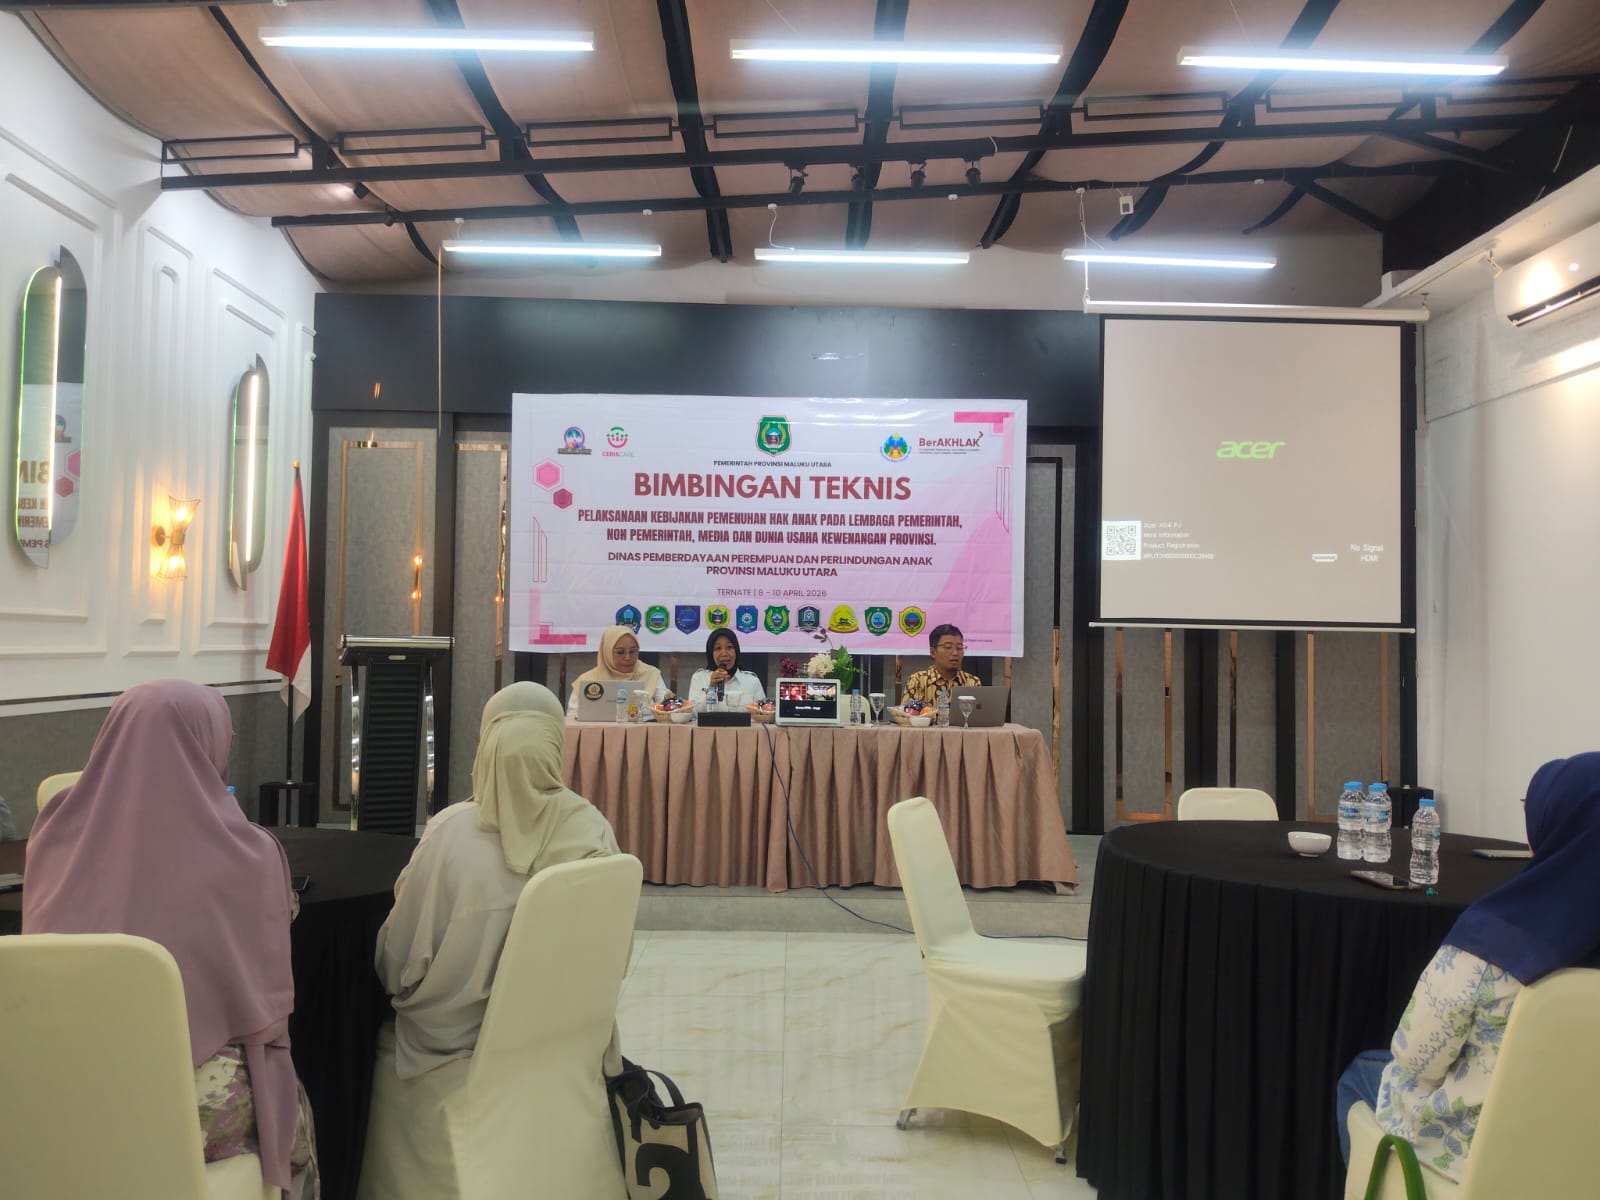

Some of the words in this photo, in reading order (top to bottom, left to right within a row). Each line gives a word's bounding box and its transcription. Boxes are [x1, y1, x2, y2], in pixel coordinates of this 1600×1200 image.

[919, 437, 981, 448] BerAKHLAK
[1216, 441, 1285, 459] acer
[634, 472, 801, 499] BIMBINGAN
[810, 476, 911, 500] TEKNIS
[578, 509, 648, 523] PELAKSANAAN
[650, 510, 704, 524] KEBIJAKAN
[707, 511, 767, 525] PEMENUHAN
[769, 512, 789, 526] HAK
[791, 513, 818, 526] ANAK
[820, 513, 846, 527] PADA
[849, 514, 895, 528] LEMBAGA
[899, 514, 963, 529] PEMERINTAH,
[606, 528, 627, 541] NON
[629, 529, 695, 544] PEMERINTAH,
[698, 530, 730, 543] MEDIA
[732, 530, 751, 543] DAN
[755, 531, 784, 543] DUNIA
[786, 531, 819, 544] USAHA
[821, 532, 887, 546] KEWENANGAN
[889, 533, 937, 546] PROVINSI.
[1350, 543, 1361, 552] No
[1362, 543, 1384, 553] Signal
[608, 552, 641, 561] DINAS
[643, 552, 730, 564] PEMBERDAYAAN
[731, 554, 795, 565] PEREMPUAN
[795, 555, 819, 565] DAN
[820, 555, 900, 566] PERLINDUNGAN
[902, 556, 933, 566] ANAK
[706, 565, 755, 576] PROVINSI
[756, 566, 801, 576] MALUKU
[802, 567, 838, 577] UTARA
[717, 588, 751, 597] TERNATE
[773, 588, 781, 597] 10
[783, 588, 805, 597] APRIL
